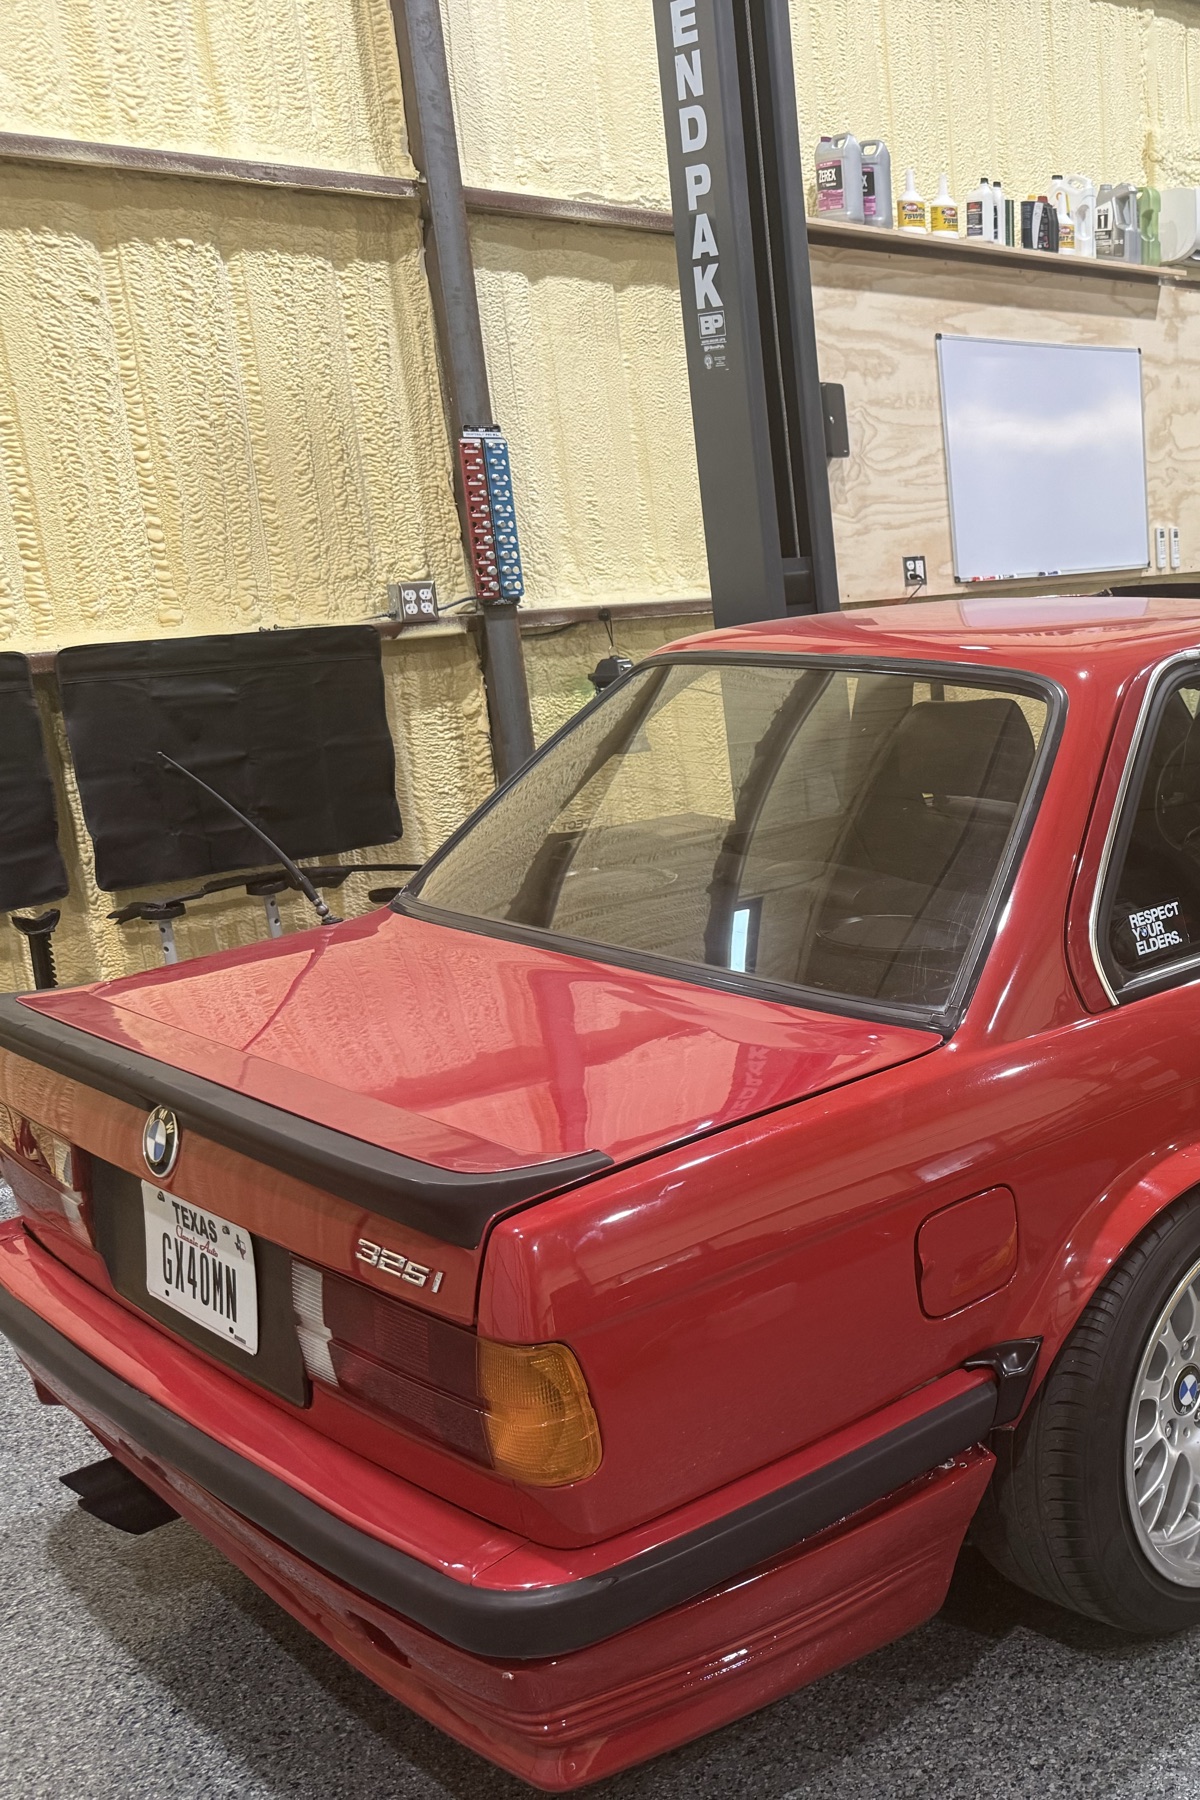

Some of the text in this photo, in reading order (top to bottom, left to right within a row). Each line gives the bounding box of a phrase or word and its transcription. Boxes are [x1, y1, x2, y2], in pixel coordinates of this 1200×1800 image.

[670, 0, 724, 310] ENDPAK
[818, 168, 836, 184] ZEREX
[1128, 901, 1179, 929] RESPECT
[1135, 930, 1183, 956] ELDERS.
[171, 1200, 218, 1243] TEXAS
[175, 1224, 219, 1258] Classic Auto
